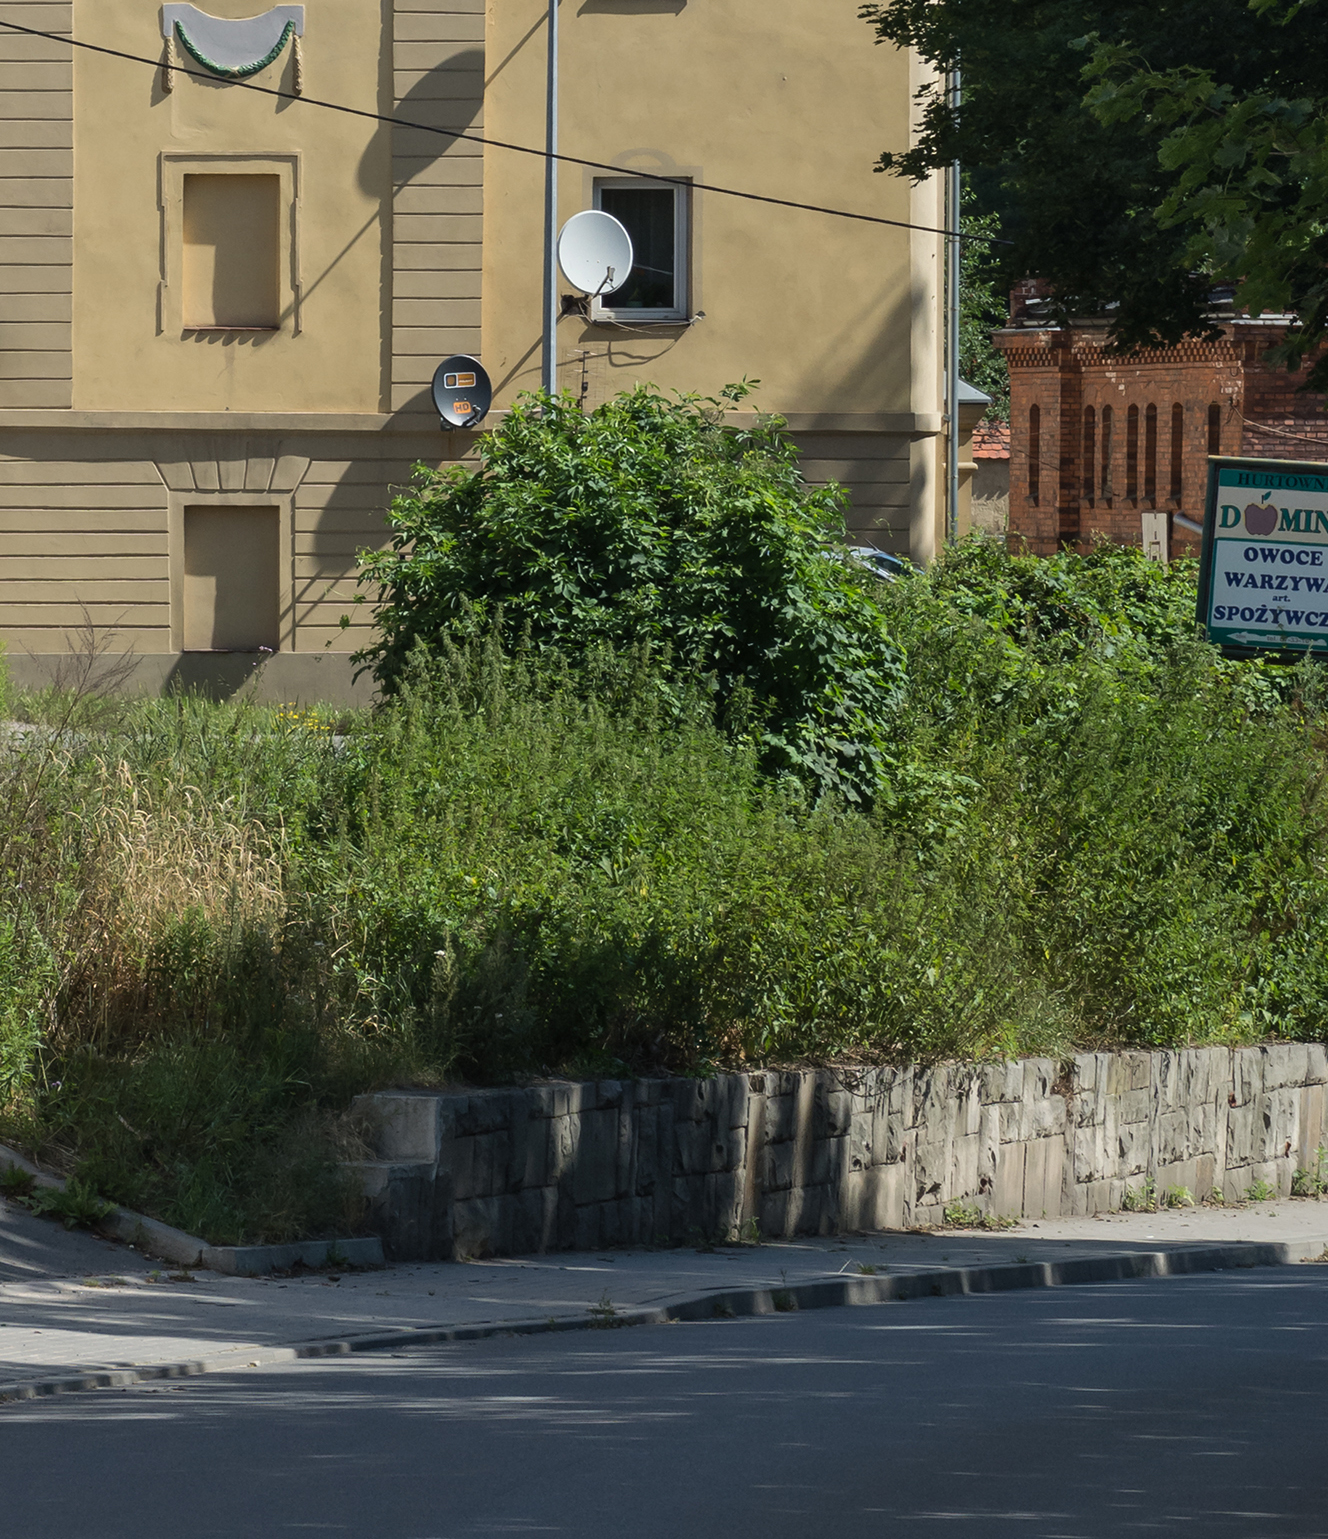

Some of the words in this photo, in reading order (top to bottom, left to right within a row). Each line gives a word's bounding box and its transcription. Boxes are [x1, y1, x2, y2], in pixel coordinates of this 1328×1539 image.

[455, 403, 470, 412] HD
[1237, 473, 1328, 490] HURTOWN
[1243, 547, 1324, 567] OWOCE
